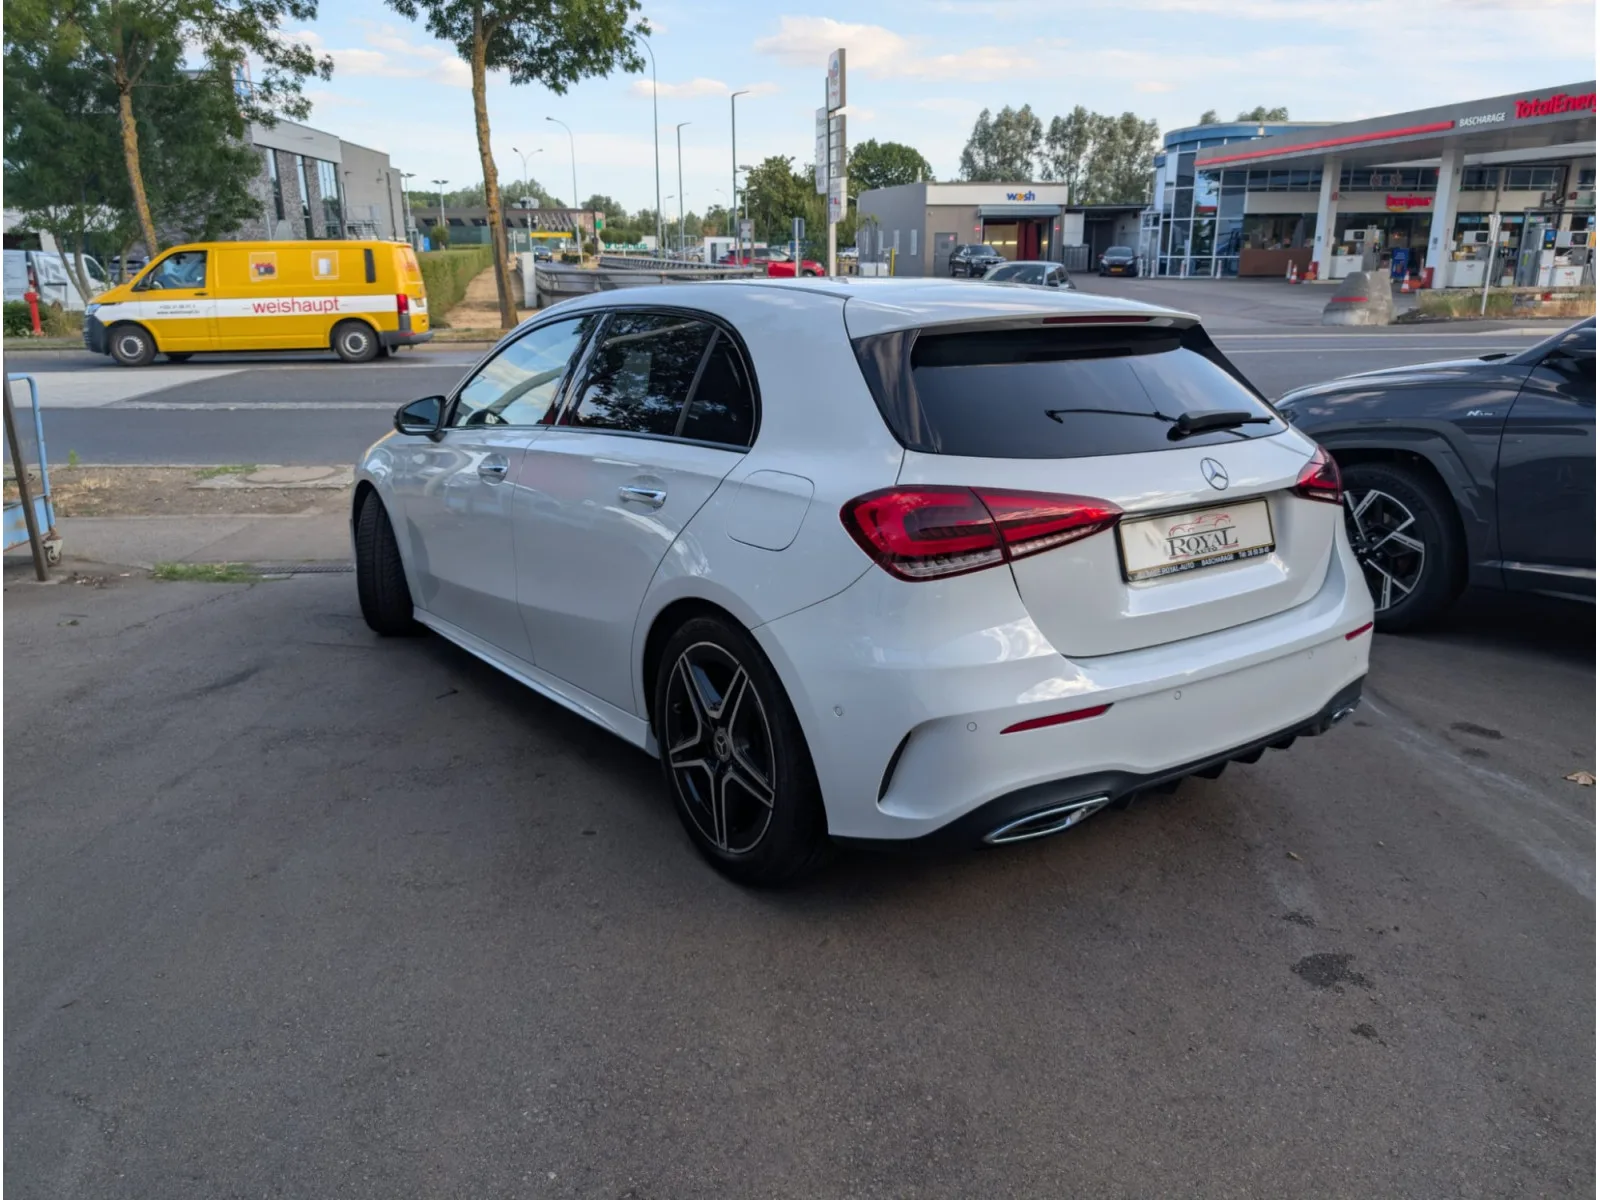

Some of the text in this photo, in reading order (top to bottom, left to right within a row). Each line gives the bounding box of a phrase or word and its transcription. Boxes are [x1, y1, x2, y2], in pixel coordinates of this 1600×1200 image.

[1459, 111, 1506, 128] BASCHARAGE
[1006, 190, 1036, 201] wash
[252, 297, 340, 314] weishaupt
[1168, 530, 1238, 556] ROYAL
[1194, 545, 1218, 555] AUTO
